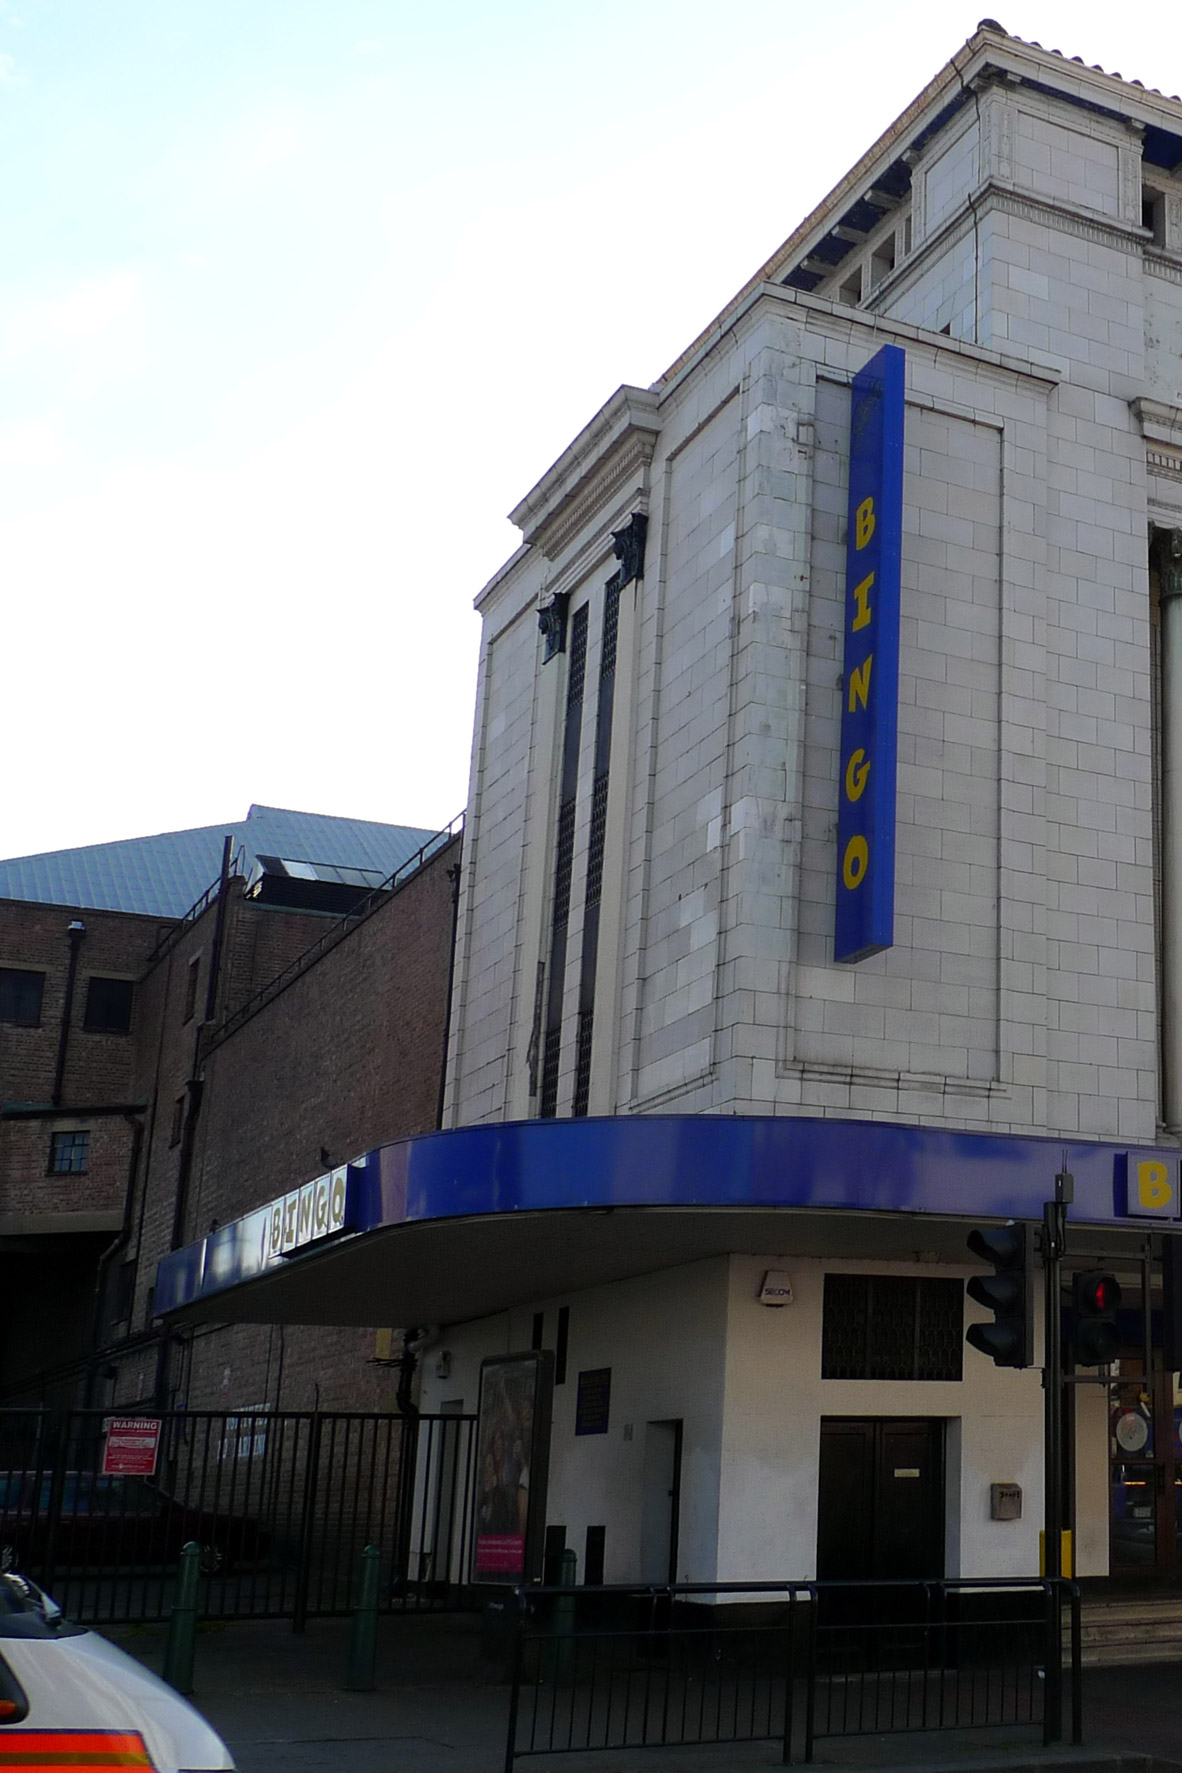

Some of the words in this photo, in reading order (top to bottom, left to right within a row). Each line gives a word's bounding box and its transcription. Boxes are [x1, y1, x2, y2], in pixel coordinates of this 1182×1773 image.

[842, 495, 876, 890] BINGO
[271, 1176, 345, 1250] BINGO
[112, 1420, 157, 1430] WARNING
